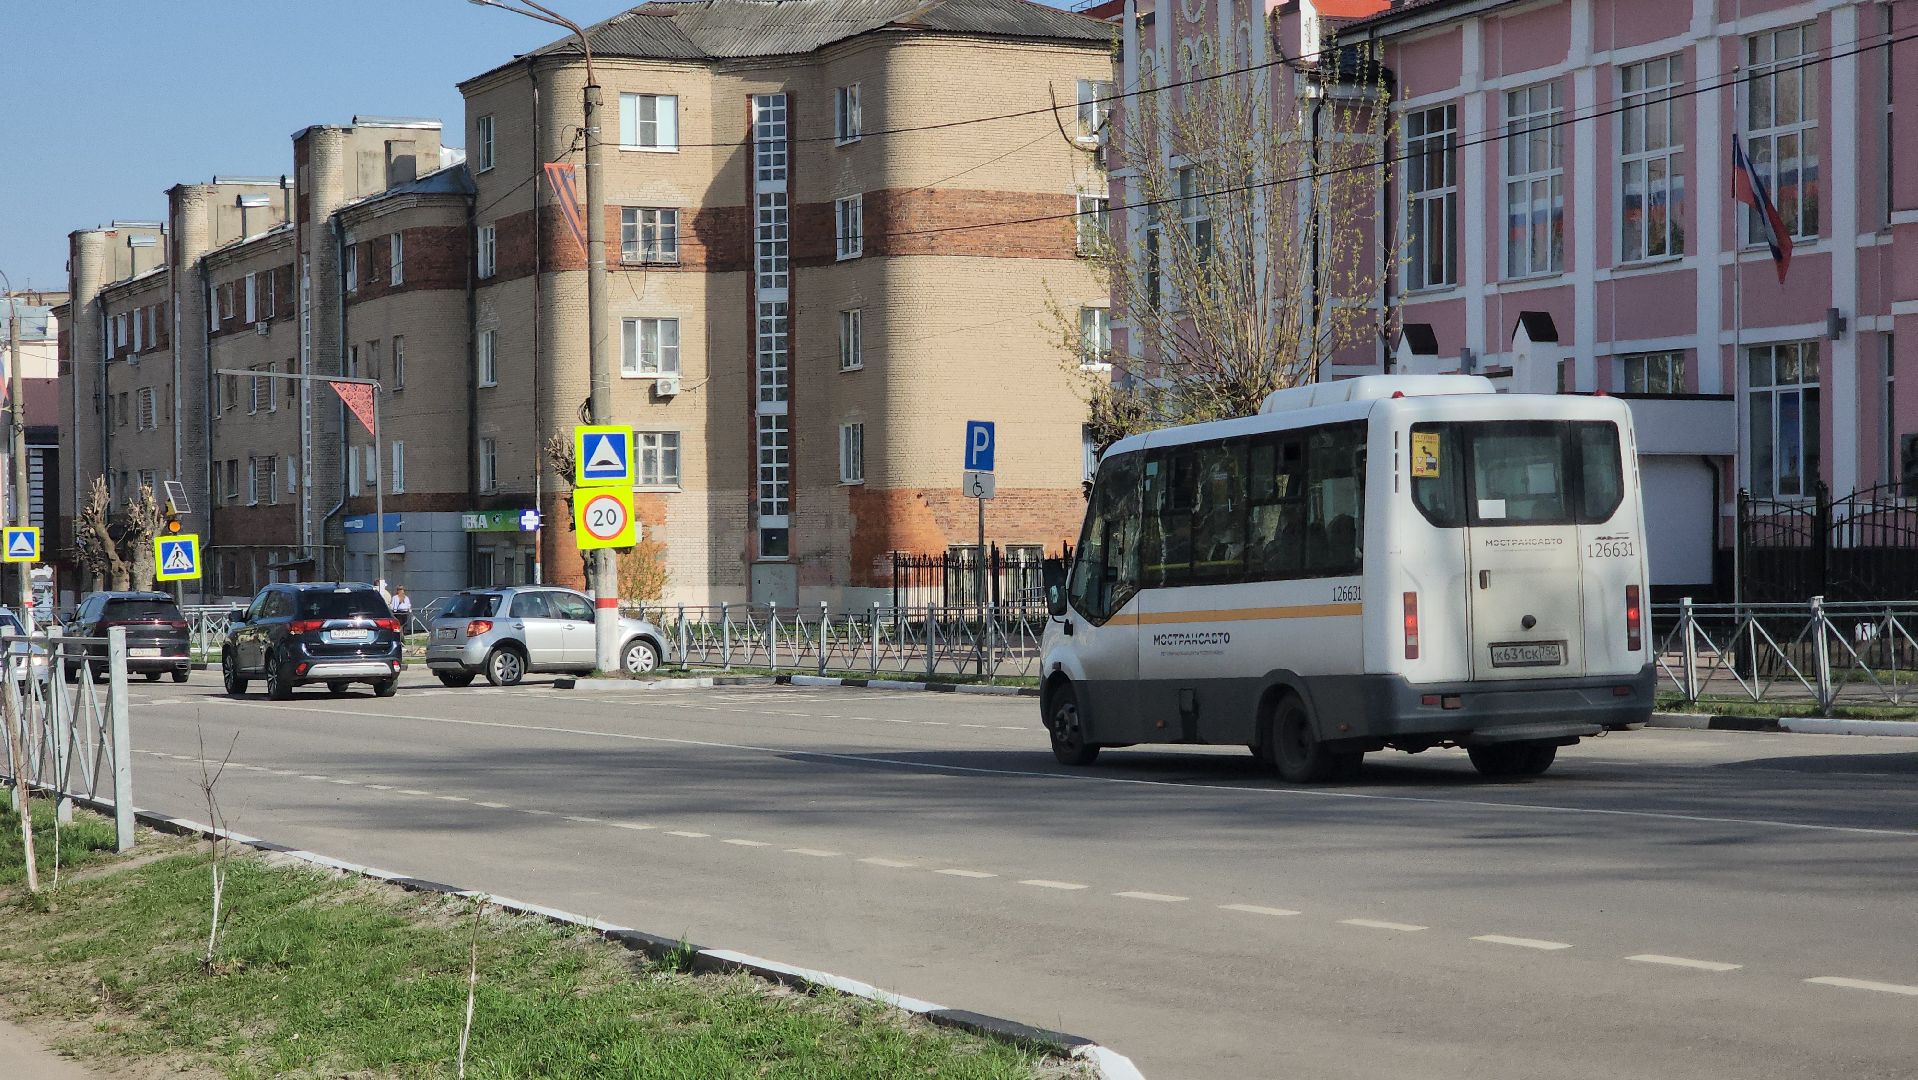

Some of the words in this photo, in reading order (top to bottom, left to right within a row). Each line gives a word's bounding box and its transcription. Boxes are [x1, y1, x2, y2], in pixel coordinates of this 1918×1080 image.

[972, 426, 990, 465] P
[593, 508, 617, 527] 20
[1485, 538, 1563, 547] МОСТРАНСАВТО
[1587, 541, 1634, 558] 126631
[1332, 585, 1362, 602] 126631
[1153, 632, 1231, 646] МОСТРАНСАВТО
